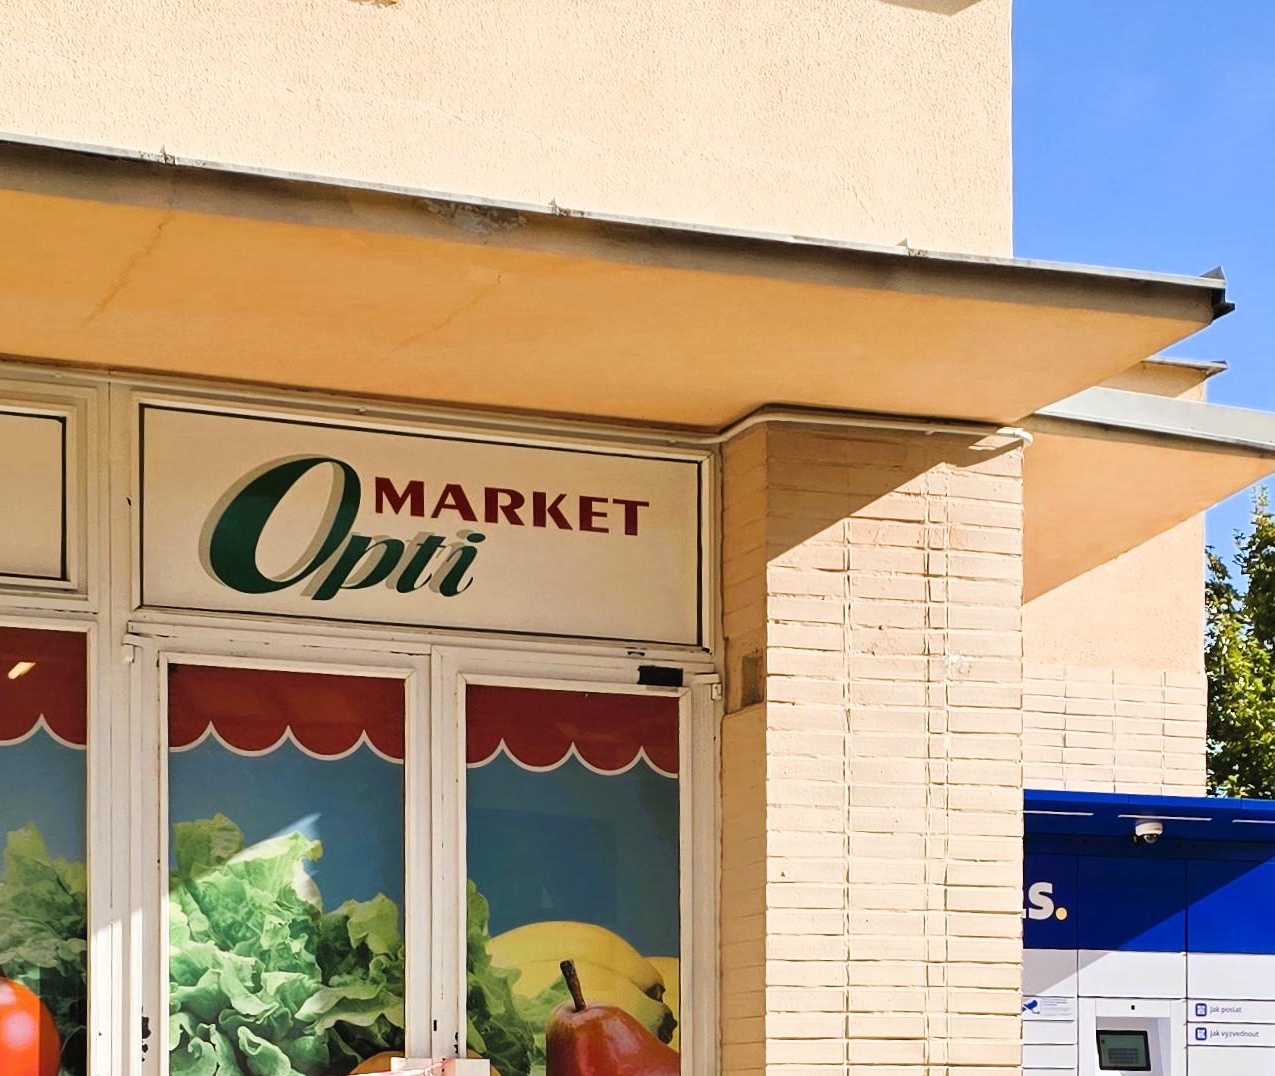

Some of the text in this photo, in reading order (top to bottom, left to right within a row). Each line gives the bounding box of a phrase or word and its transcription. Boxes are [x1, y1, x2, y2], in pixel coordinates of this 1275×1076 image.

[199, 453, 486, 600] Opti
[374, 476, 650, 536] MARKET
[1023, 882, 1068, 920] S.
[1221, 1030, 1260, 1038] vyzvednout
